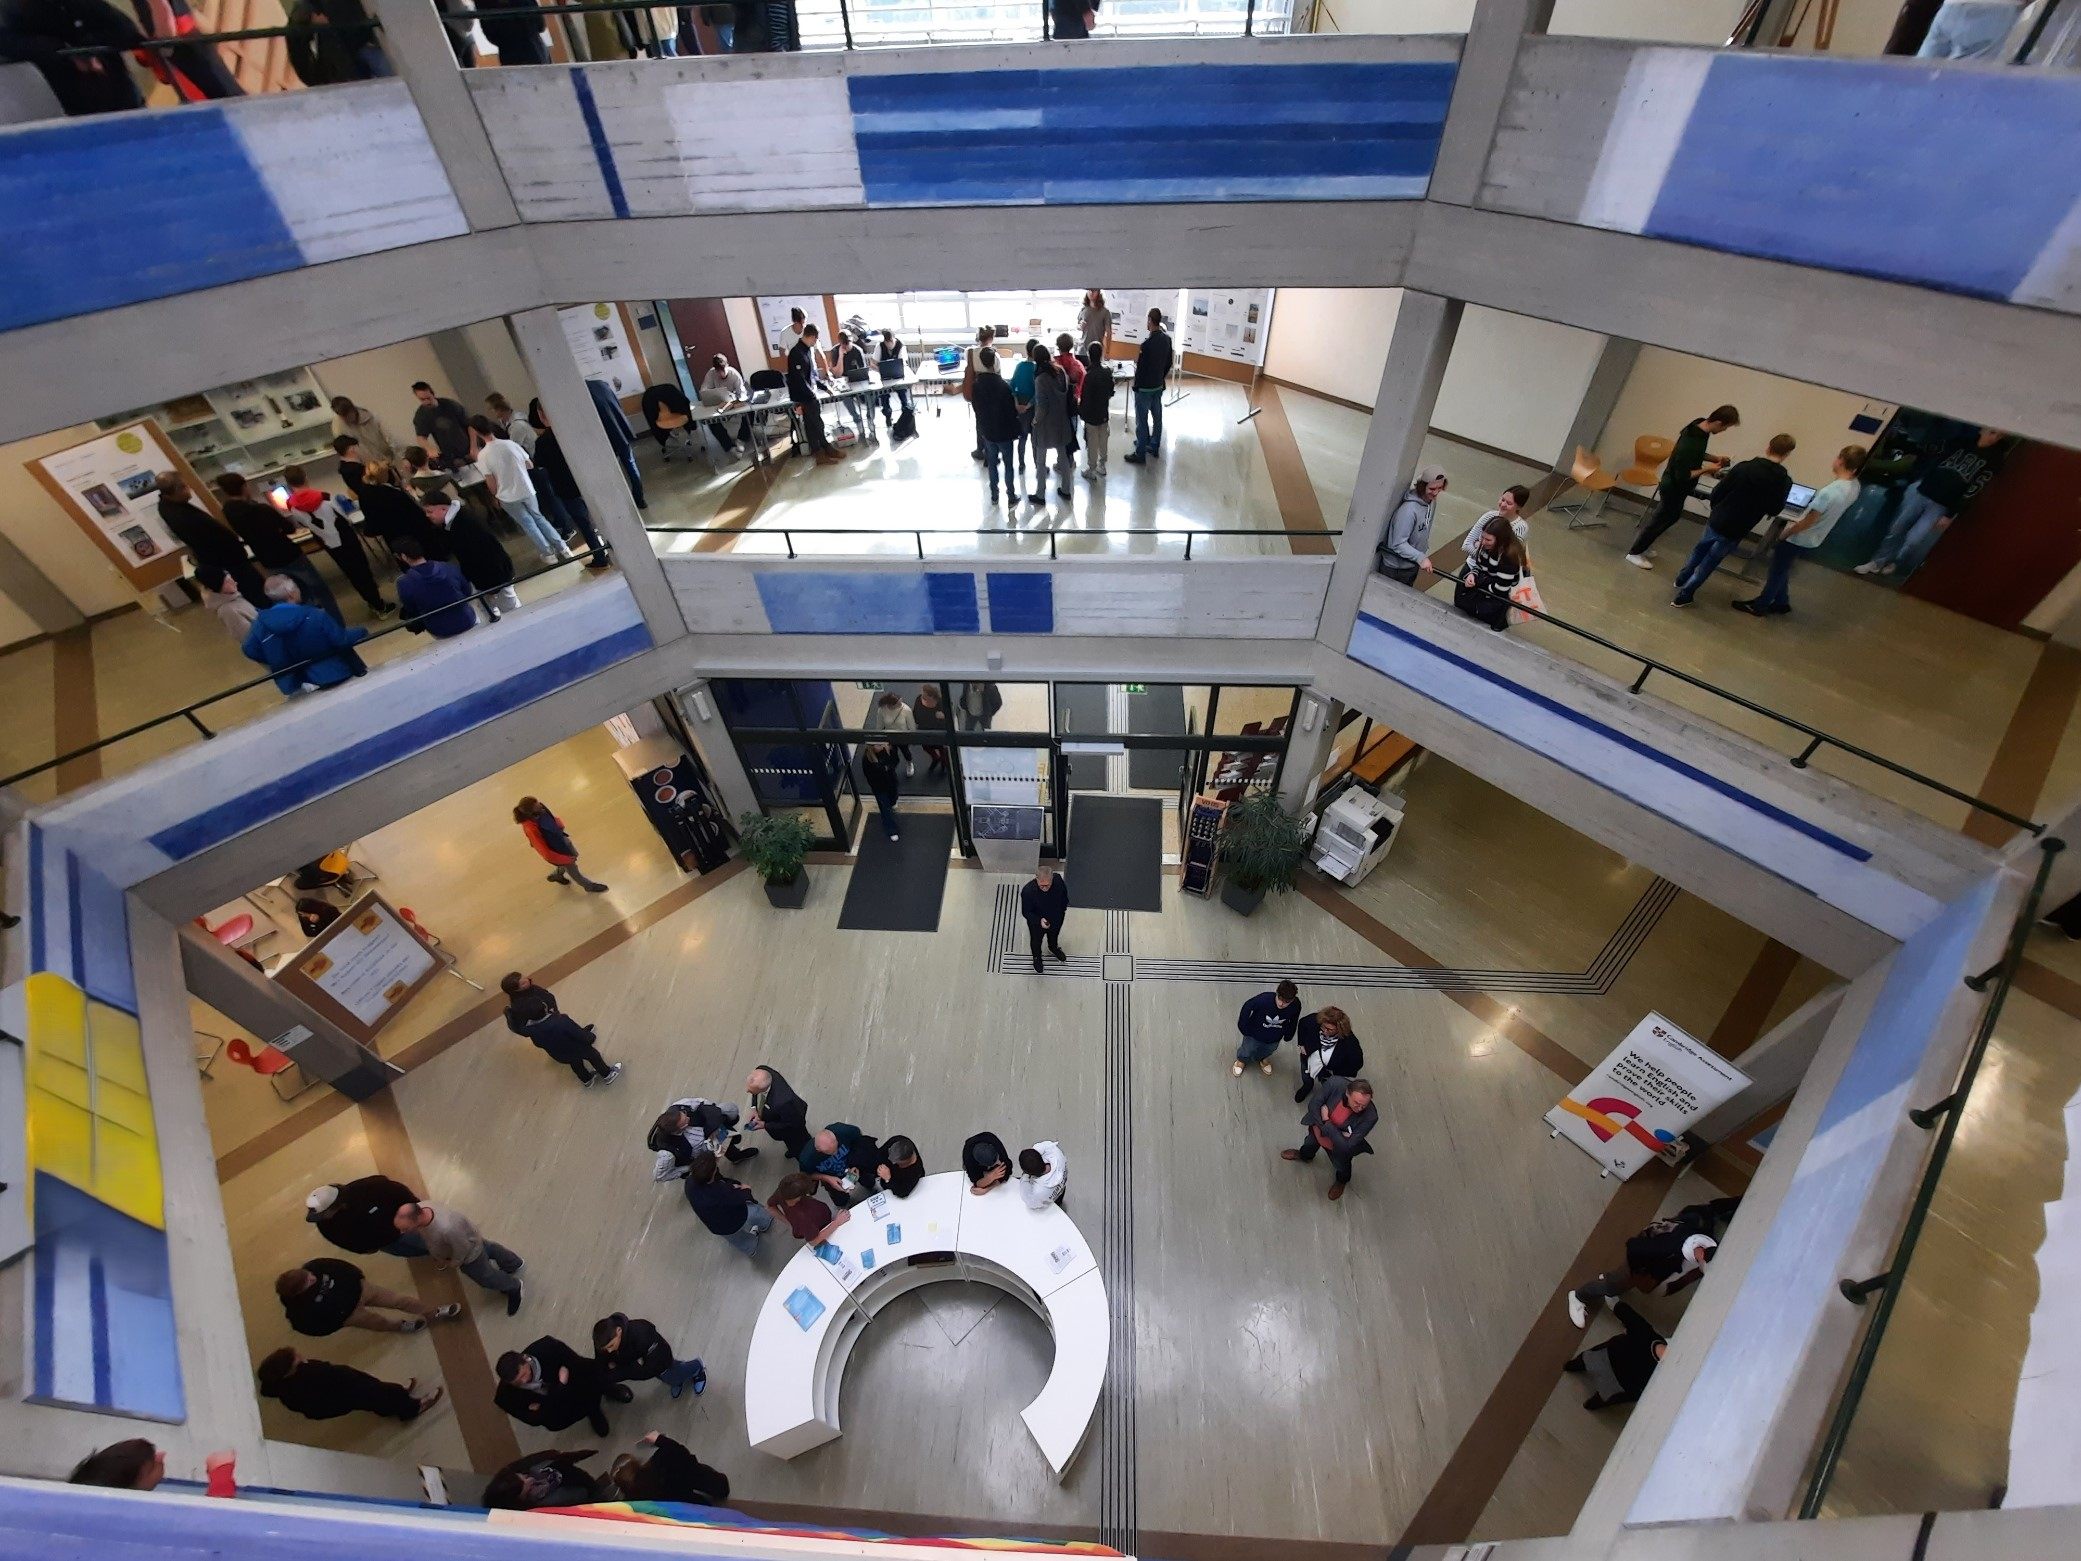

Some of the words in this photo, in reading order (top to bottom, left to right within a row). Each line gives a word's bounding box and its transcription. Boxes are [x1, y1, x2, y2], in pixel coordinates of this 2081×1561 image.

[1667, 1034, 1698, 1057] Cambridge
[1612, 1067, 1622, 1076] to
[1623, 1075, 1639, 1087] the
[1639, 1085, 1667, 1106] world
[1616, 1062, 1643, 1080] prove
[1643, 1080, 1665, 1095] their
[1665, 1096, 1688, 1114] skills
[1623, 1056, 1646, 1074] learn
[1647, 1073, 1678, 1097] English
[1679, 1098, 1699, 1111] and
[1630, 1051, 1644, 1063] We
[1645, 1062, 1665, 1078] help
[1665, 1077, 1697, 1101] people
